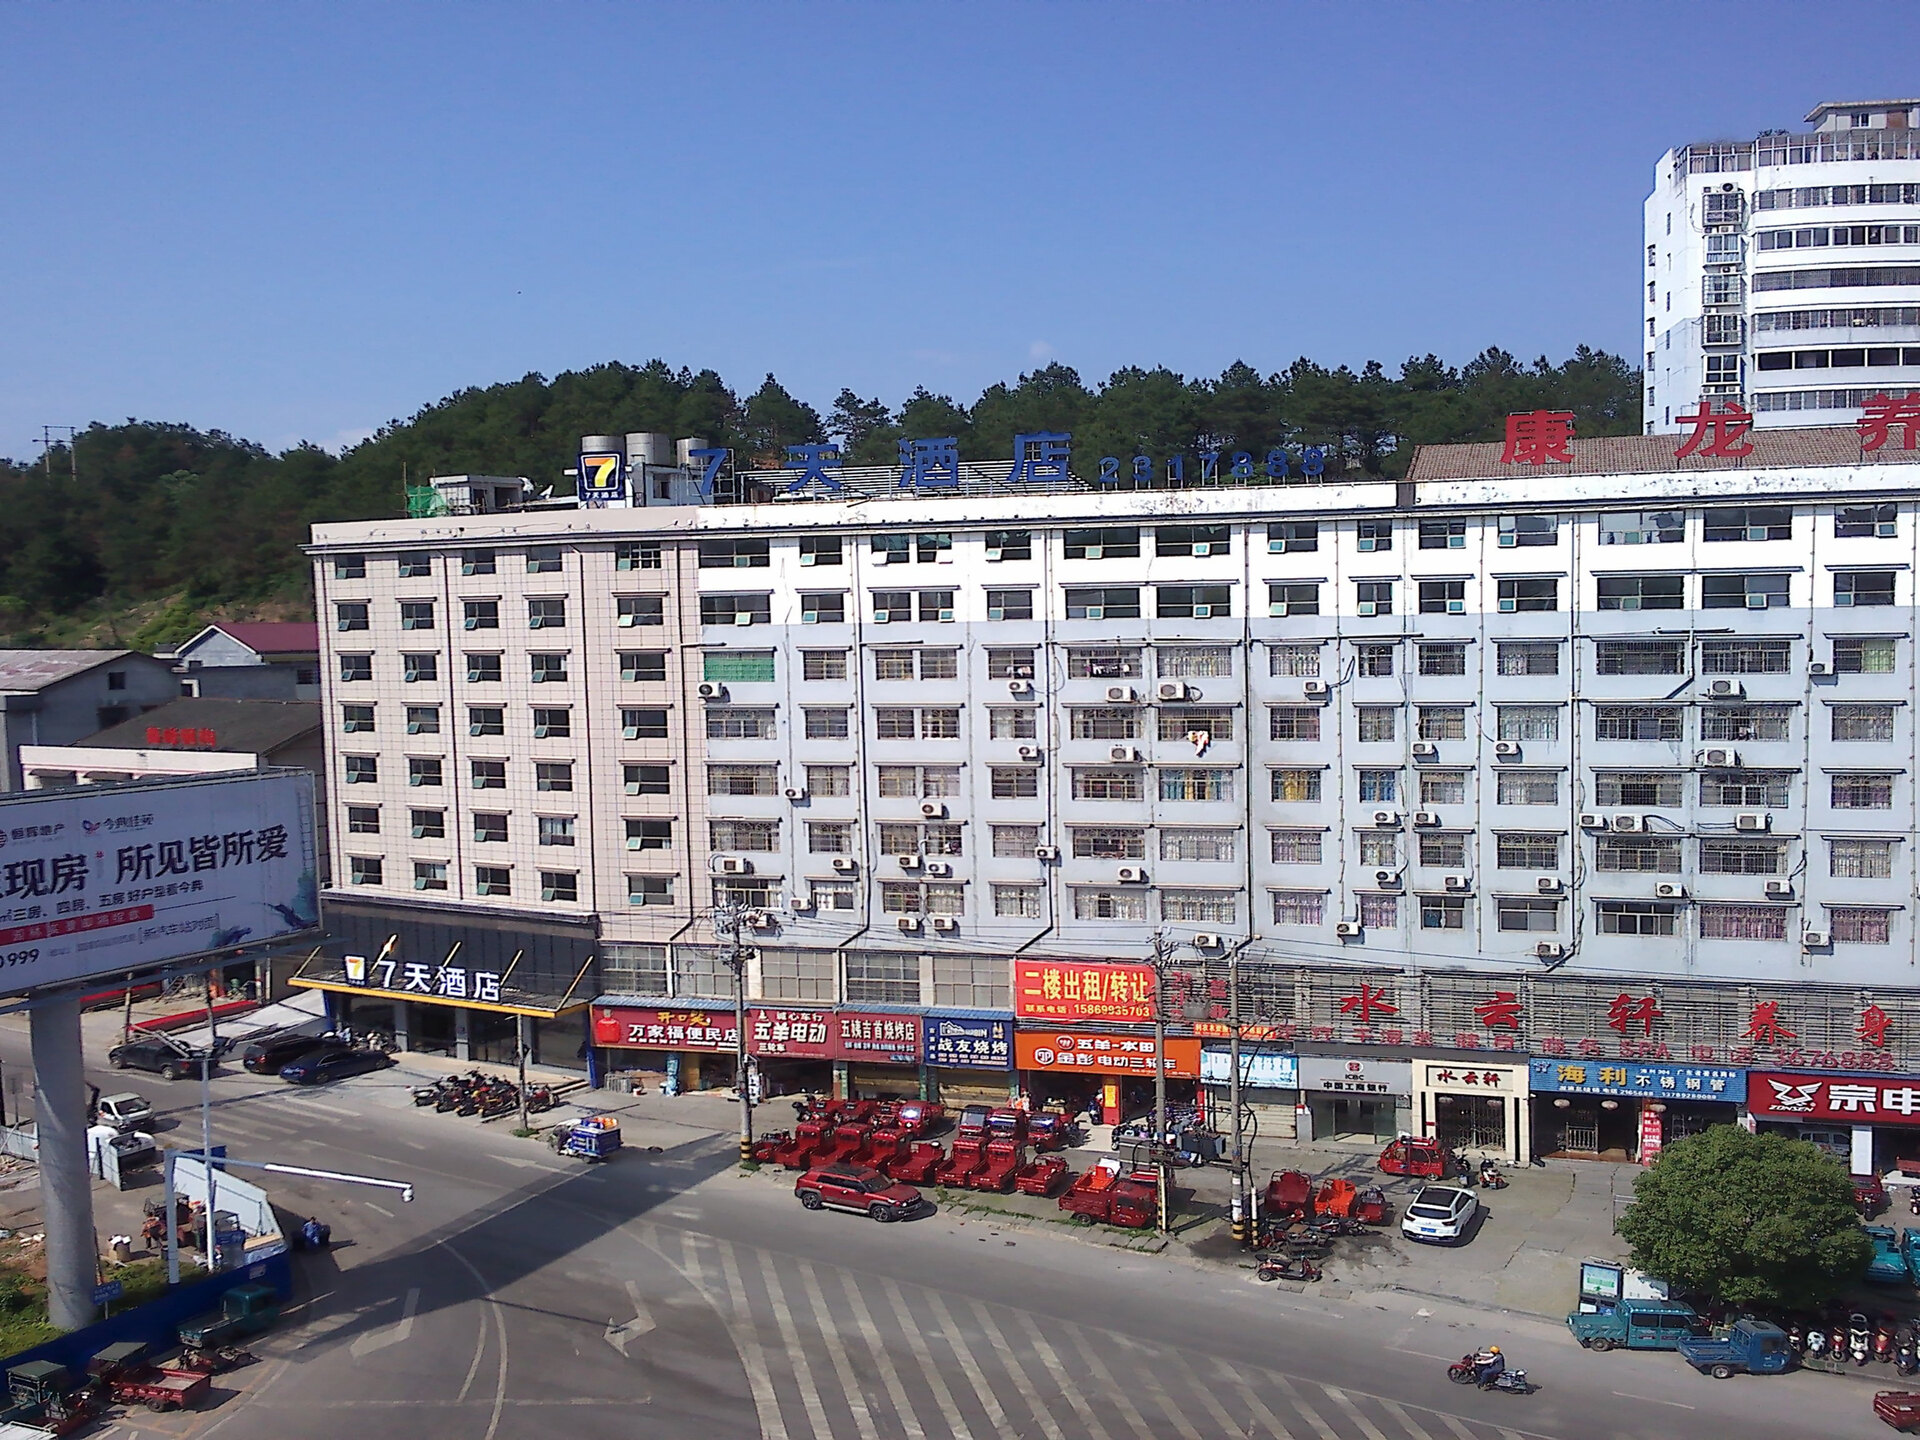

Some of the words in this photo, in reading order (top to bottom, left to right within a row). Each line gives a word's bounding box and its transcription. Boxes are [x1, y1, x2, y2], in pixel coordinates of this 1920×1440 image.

[584, 457, 616, 488] 7
[689, 432, 1071, 496] 7天酒店
[1100, 450, 1325, 482] 2317888
[0, 852, 90, 901] 现房
[115, 823, 289, 886] 所见皆所爱
[378, 960, 500, 1002] 7天酒店
[1024, 968, 1149, 1002] 二楼出租/转让
[628, 1024, 738, 1042] 万家福便民店
[754, 1022, 827, 1043] 五羊电动
[938, 1037, 1009, 1055] 战友烧烤
[1077, 1038, 1155, 1053] 五羊-本田
[1437, 1068, 1502, 1088] 水云轩
[1557, 1065, 1627, 1086] 海利
[1635, 1075, 1725, 1092] 不锈钢管
[1323, 1081, 1388, 1093] 中国工商银行
[1828, 1085, 1920, 1115] 宗申
